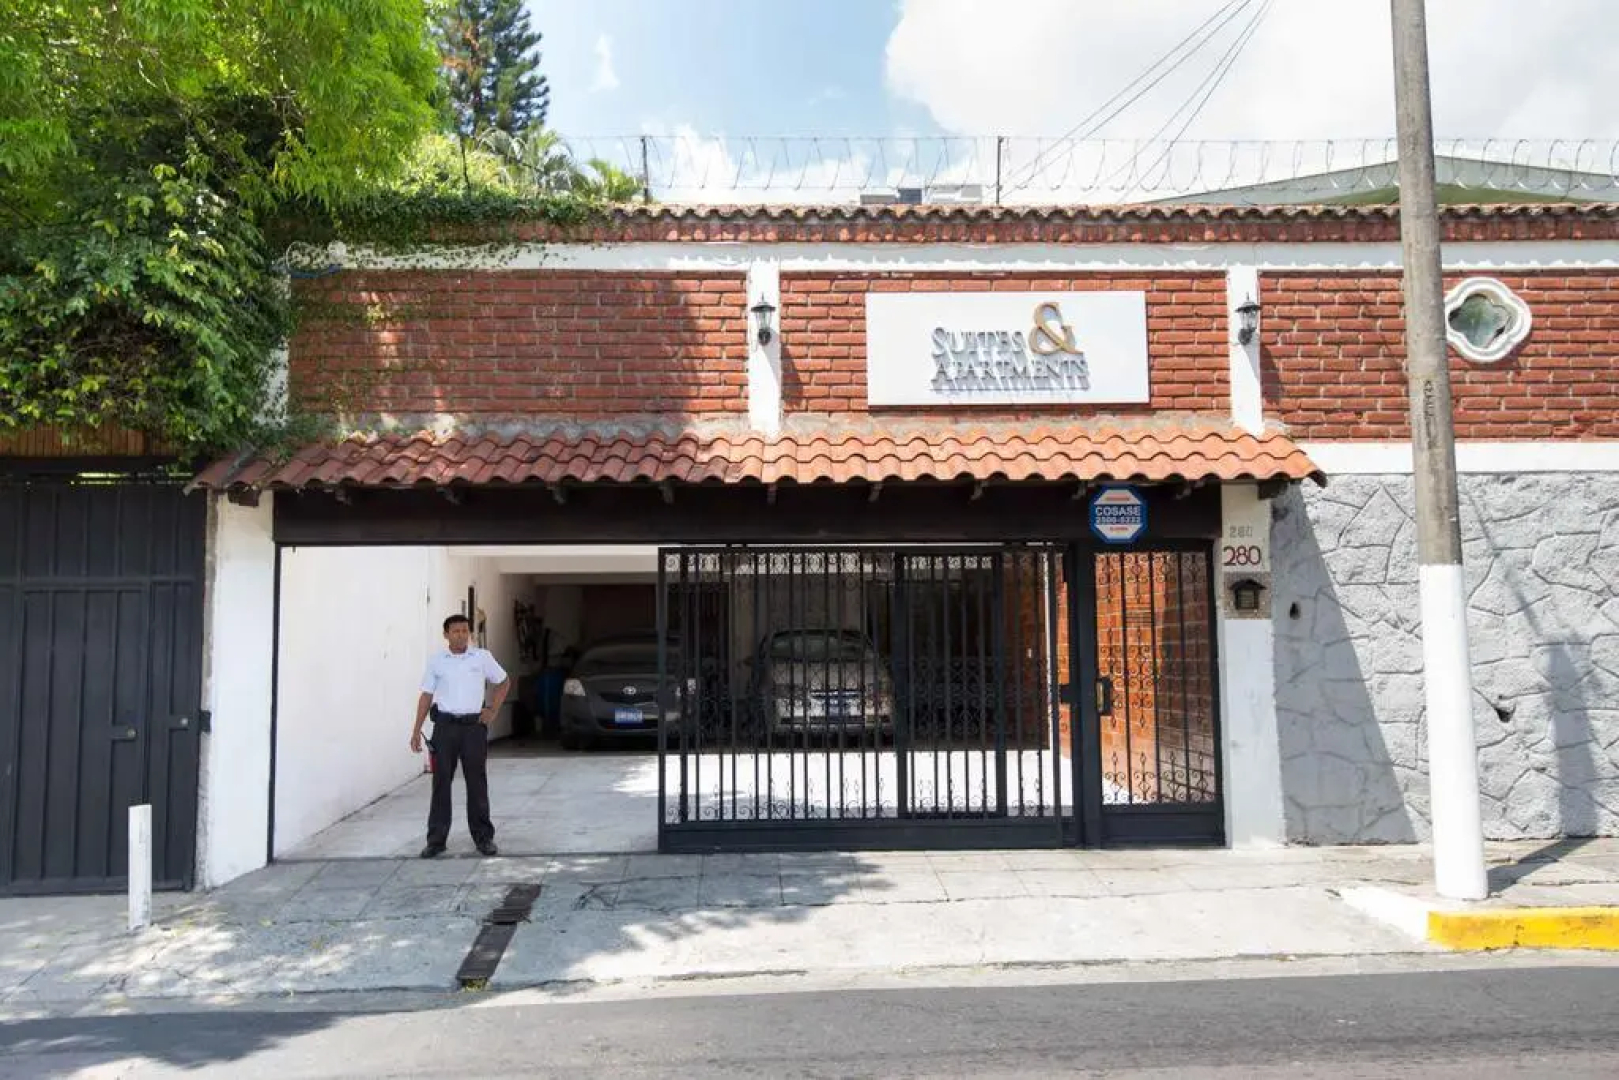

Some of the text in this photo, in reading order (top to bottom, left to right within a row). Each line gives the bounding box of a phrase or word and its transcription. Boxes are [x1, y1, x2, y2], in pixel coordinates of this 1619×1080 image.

[931, 301, 1084, 356] SUITES &
[930, 360, 1090, 389] APARTMENTS
[1095, 506, 1140, 516] COSASE
[1222, 545, 1262, 567] 280
